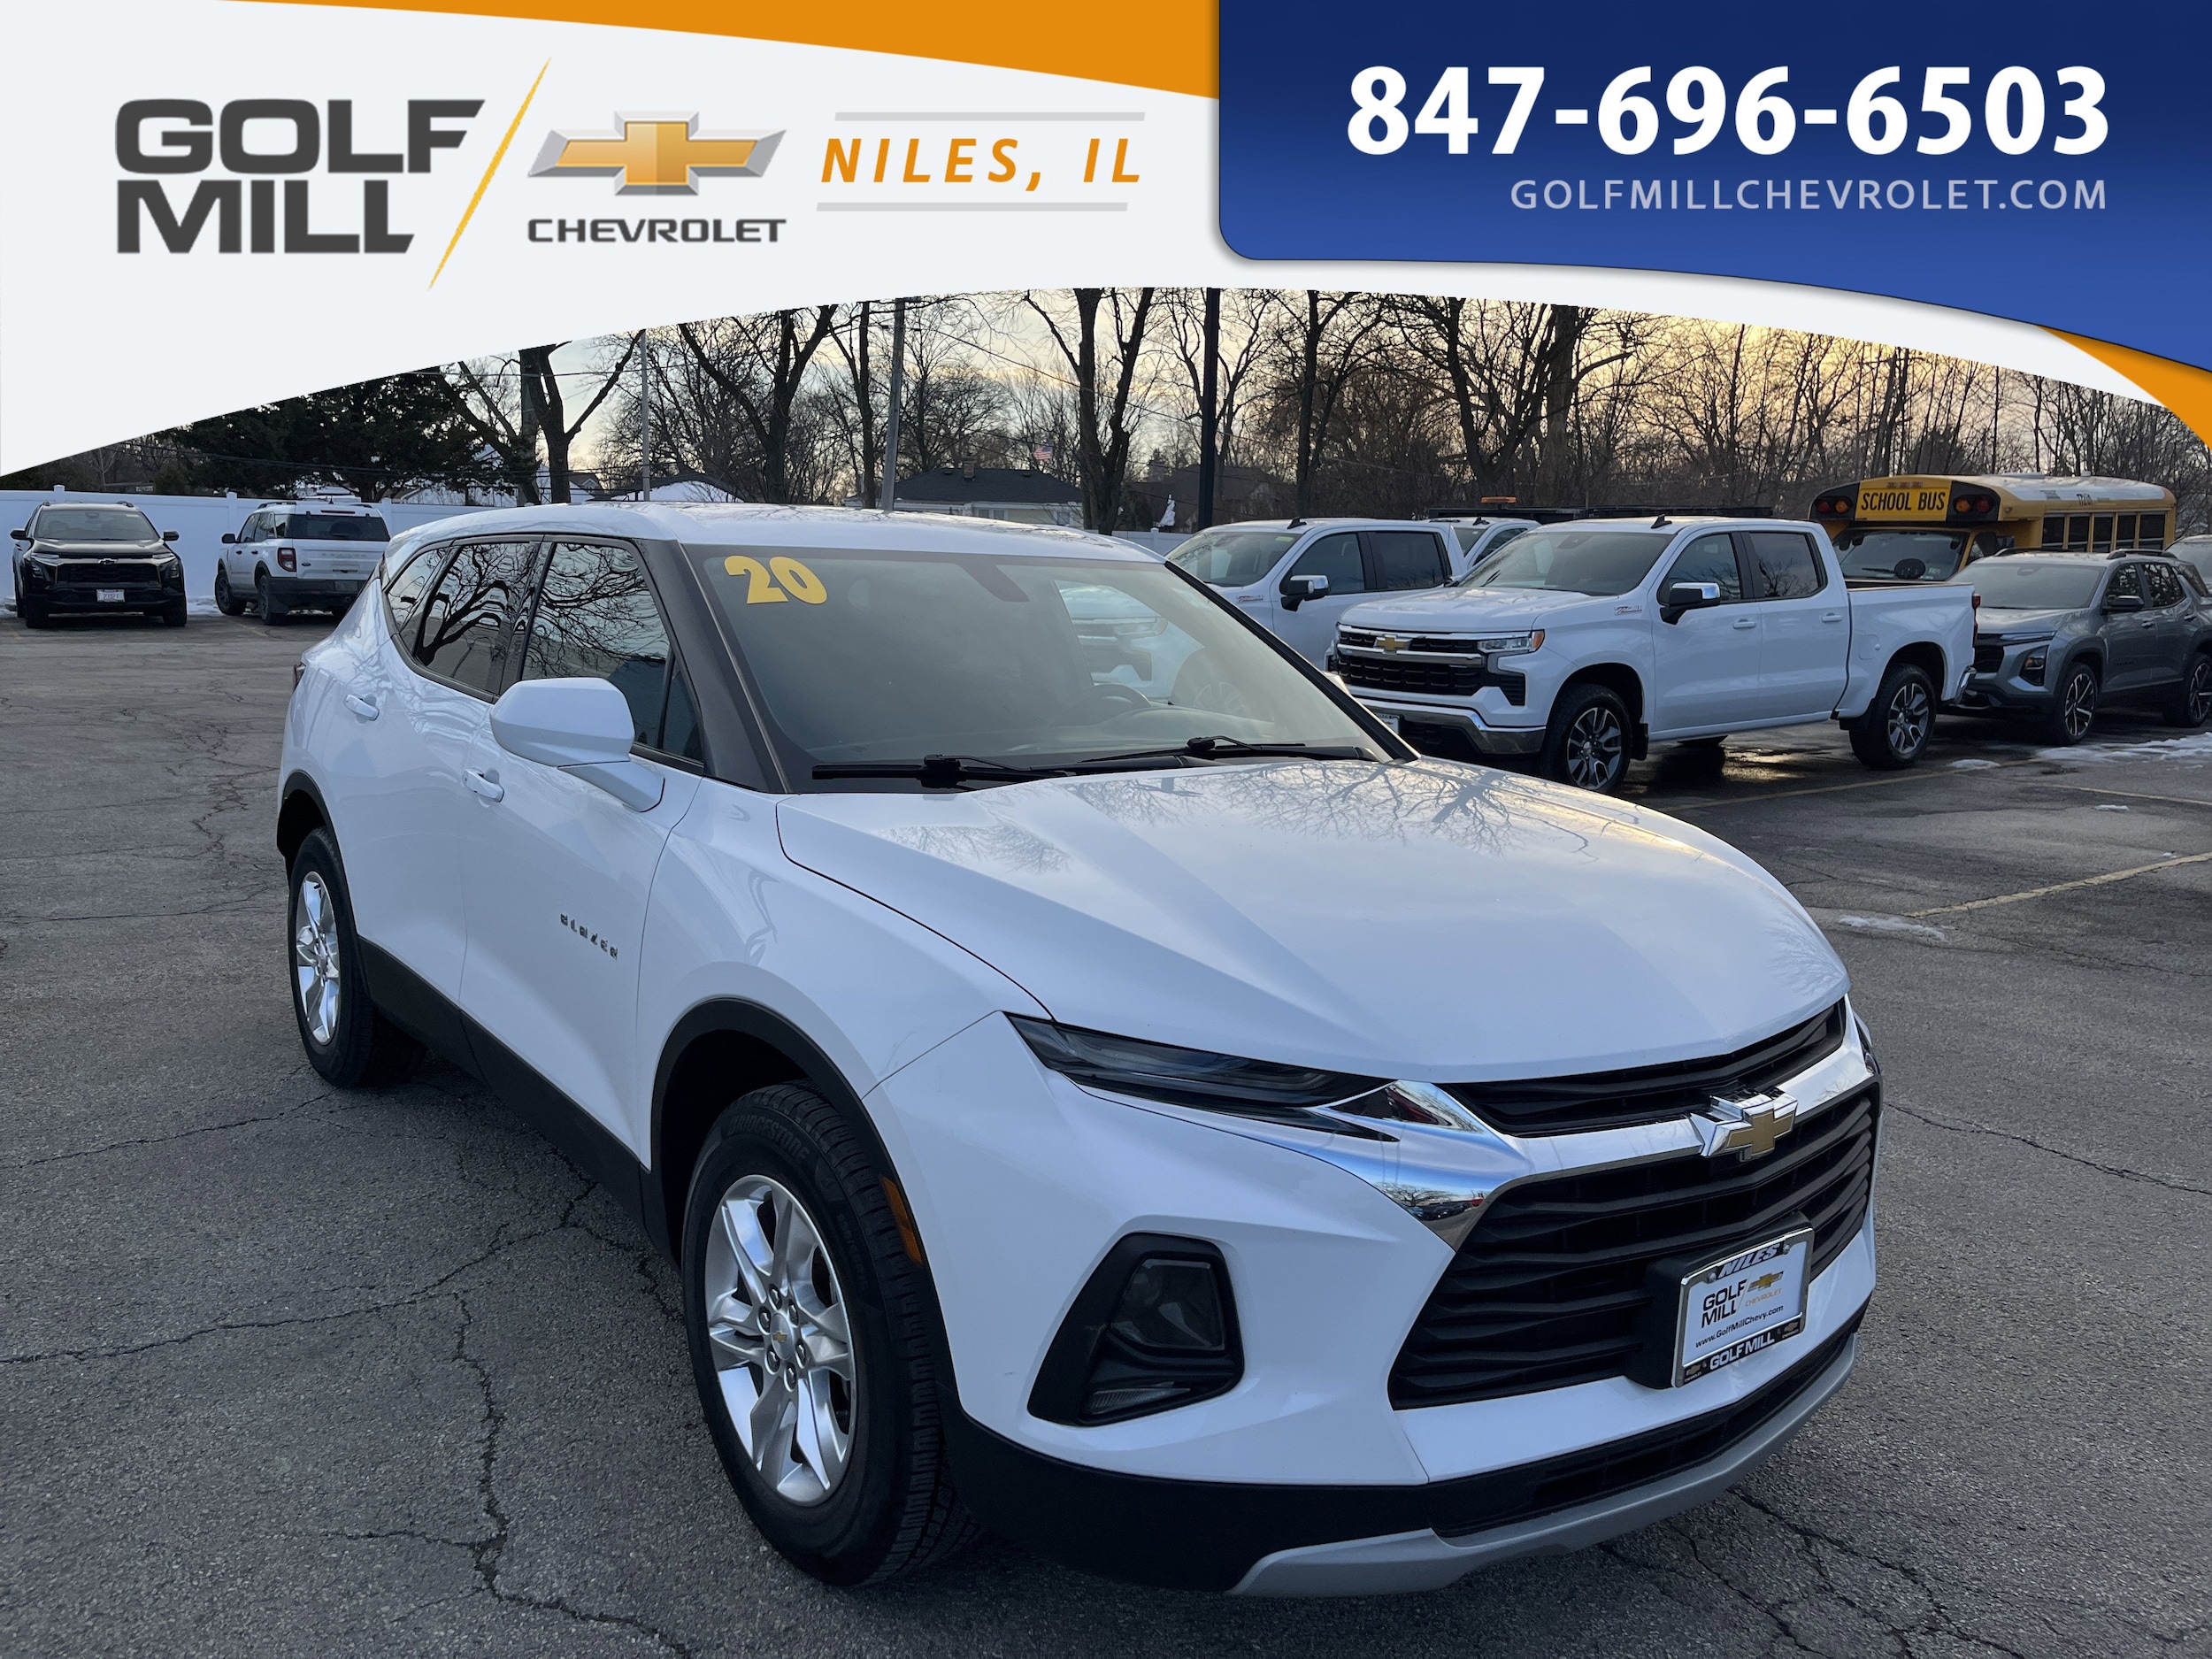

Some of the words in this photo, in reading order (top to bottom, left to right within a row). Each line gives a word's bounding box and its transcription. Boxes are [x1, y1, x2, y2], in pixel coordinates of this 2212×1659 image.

[1861, 492, 1911, 511] SCHOOL
[1917, 491, 1946, 511] BUS
[724, 556, 827, 604] 20
[1717, 1242, 1781, 1279] NILES
[1702, 1279, 1747, 1311] GOLF
[1745, 1287, 1782, 1307] CHEVROLET
[1695, 1305, 1784, 1348] www.GolfMillChevy.com
[1701, 1300, 1737, 1328] MILL
[1709, 1345, 1745, 1371] GOLF
[1745, 1332, 1775, 1355] MILL
